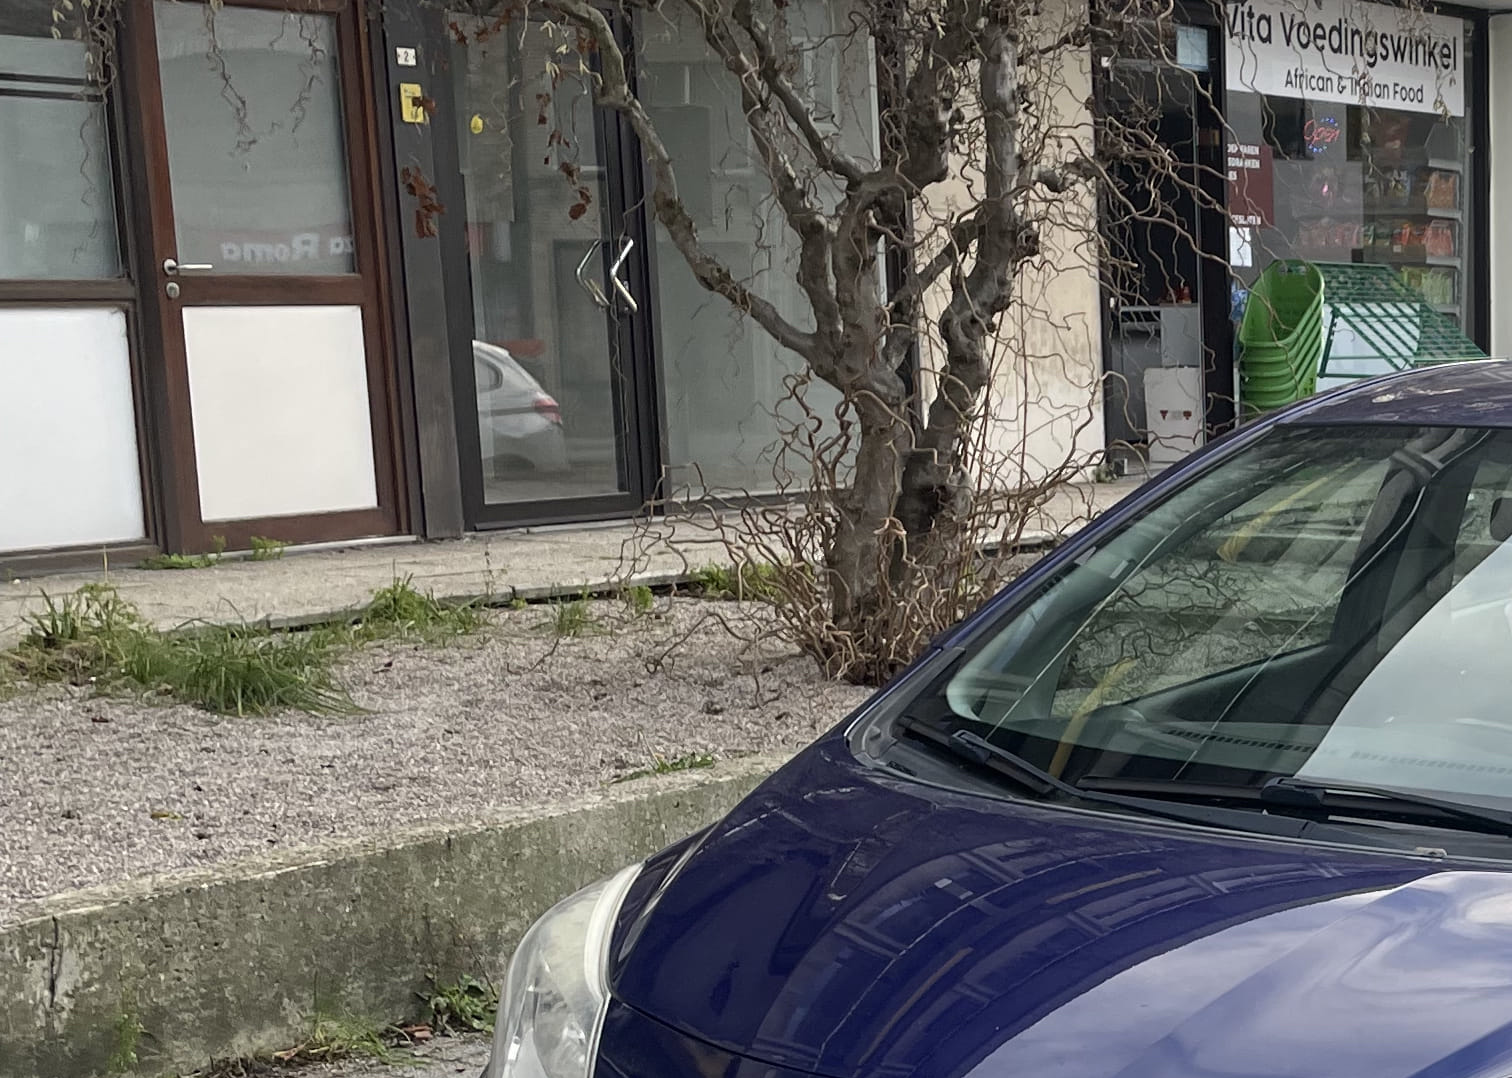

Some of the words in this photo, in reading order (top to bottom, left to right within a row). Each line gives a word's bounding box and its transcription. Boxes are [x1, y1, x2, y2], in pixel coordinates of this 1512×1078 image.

[1226, 3, 1272, 44] Vita
[1280, 11, 1458, 71] Voedingswinkel
[1284, 68, 1334, 94] African
[1337, 78, 1347, 95] &
[1393, 83, 1424, 104] Food
